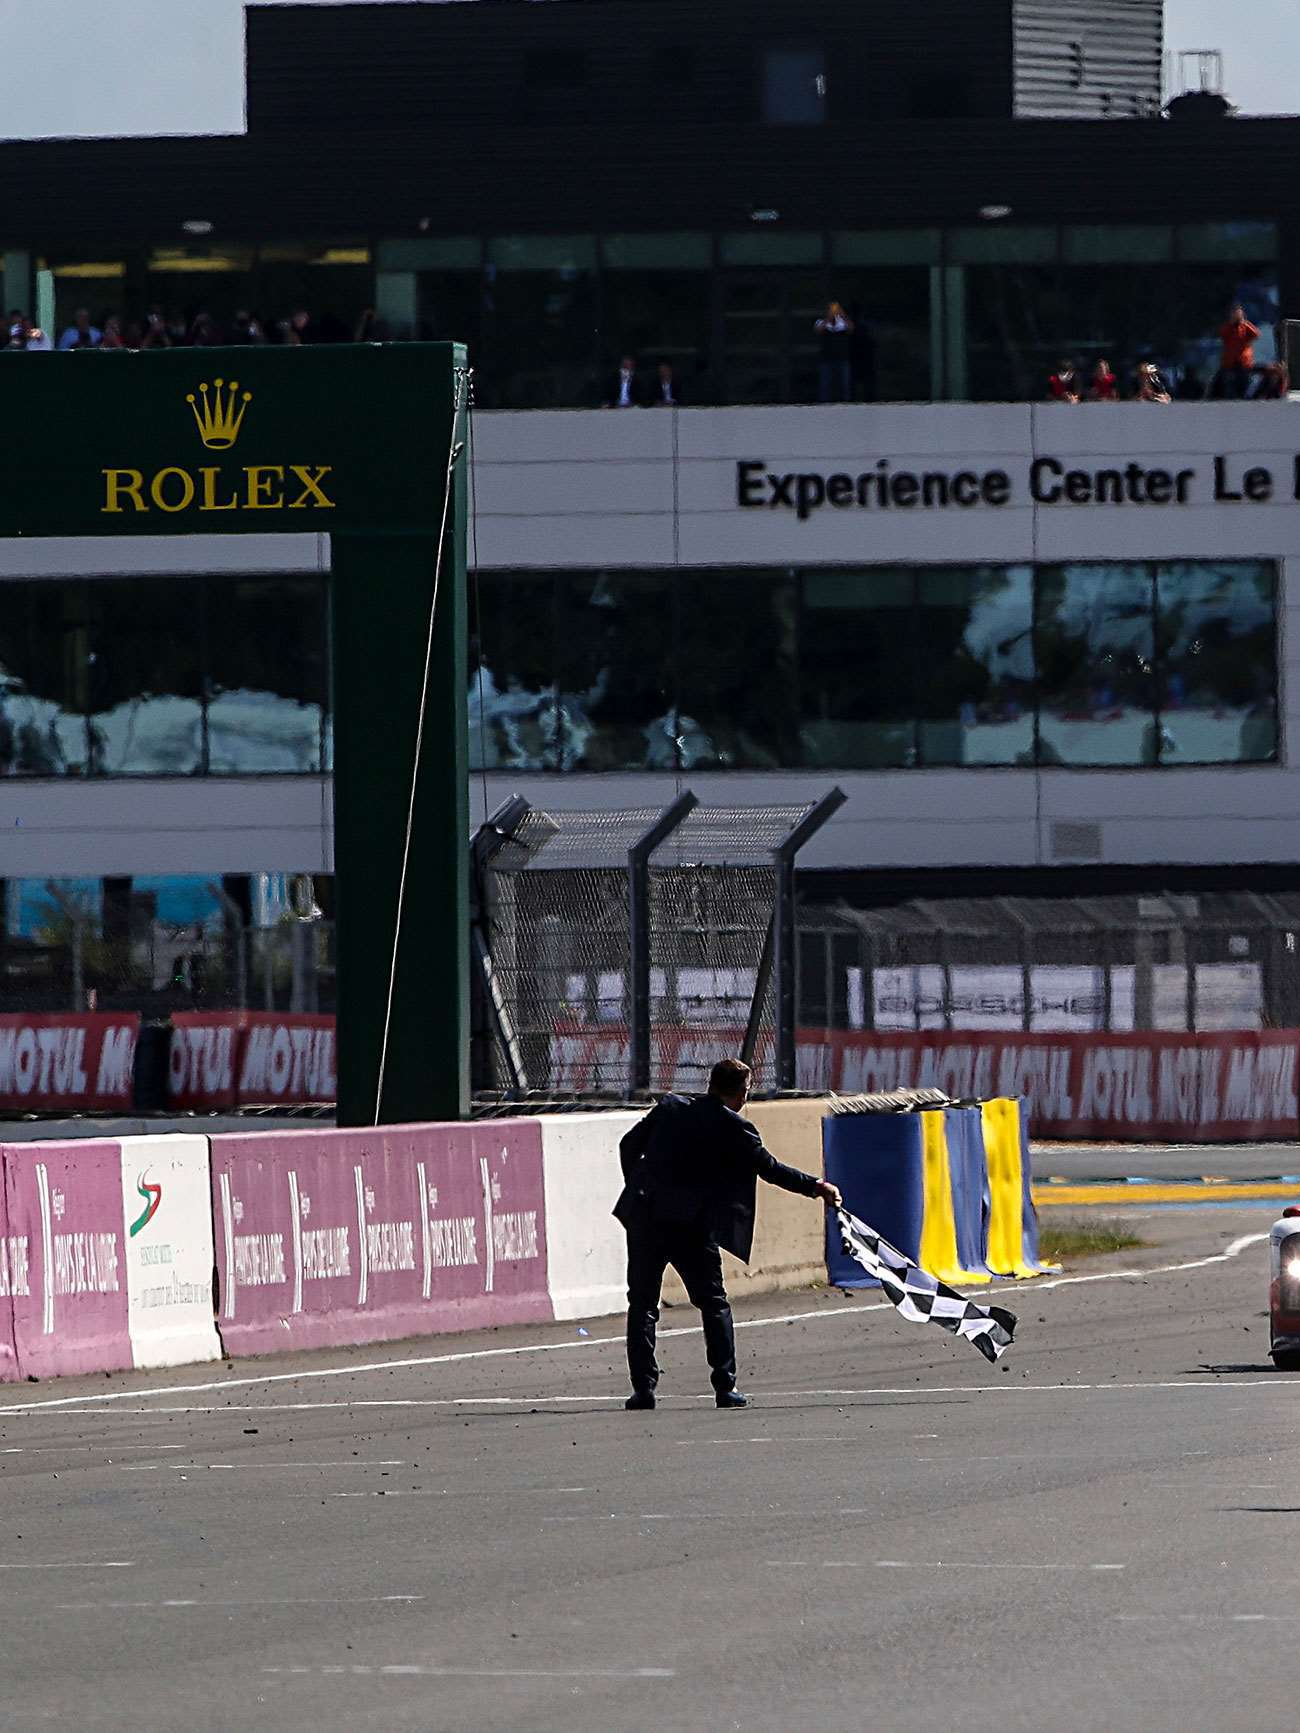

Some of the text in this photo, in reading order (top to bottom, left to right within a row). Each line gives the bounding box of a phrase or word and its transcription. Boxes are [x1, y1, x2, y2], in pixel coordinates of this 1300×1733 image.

[101, 465, 336, 513] ROLEX
[736, 458, 1012, 522] Experience
[1028, 456, 1196, 505] Center
[1213, 454, 1273, 502] Le
[240, 1025, 337, 1095] MOTUL
